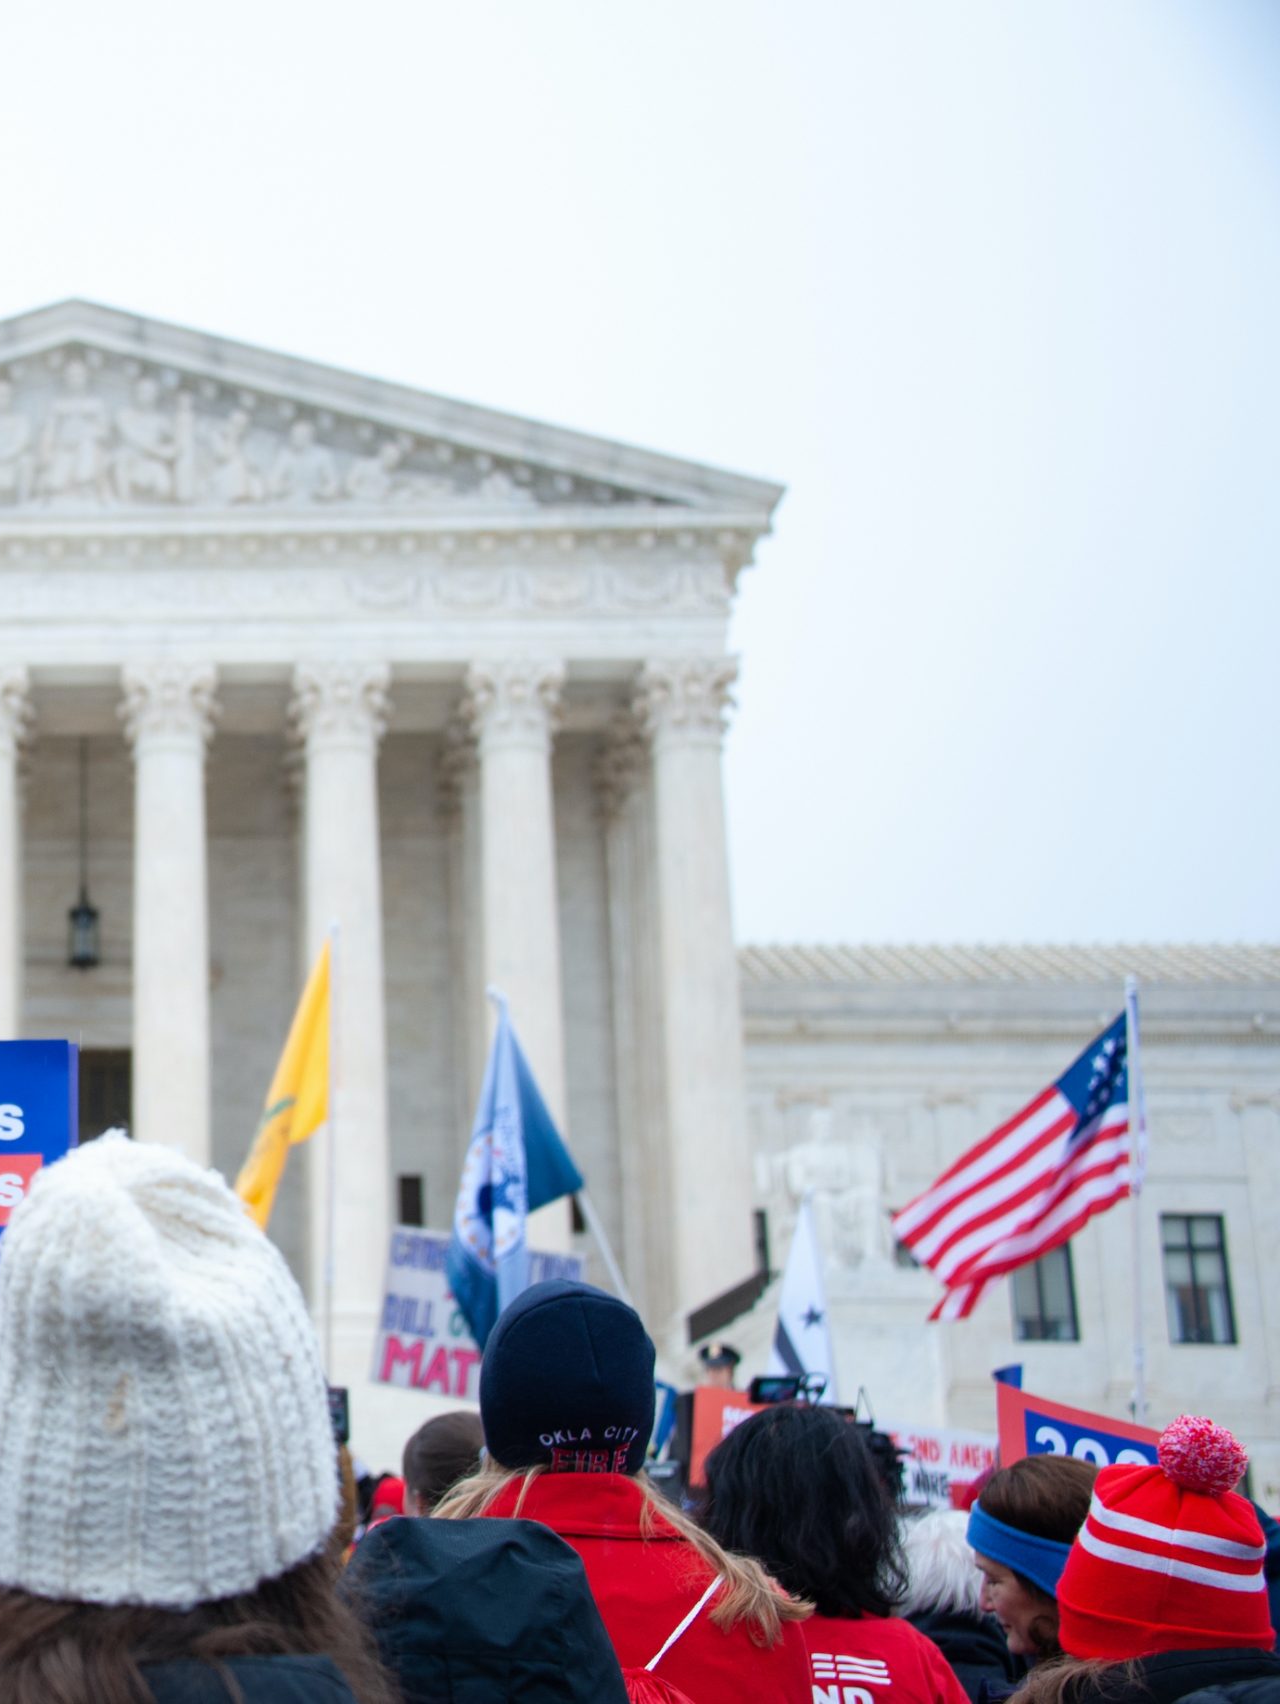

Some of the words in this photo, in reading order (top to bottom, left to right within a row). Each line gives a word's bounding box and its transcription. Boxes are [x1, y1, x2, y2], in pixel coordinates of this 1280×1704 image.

[539, 1427, 592, 1446] OKLA
[604, 1425, 639, 1442] CITY
[552, 1442, 631, 1473] FIRE
